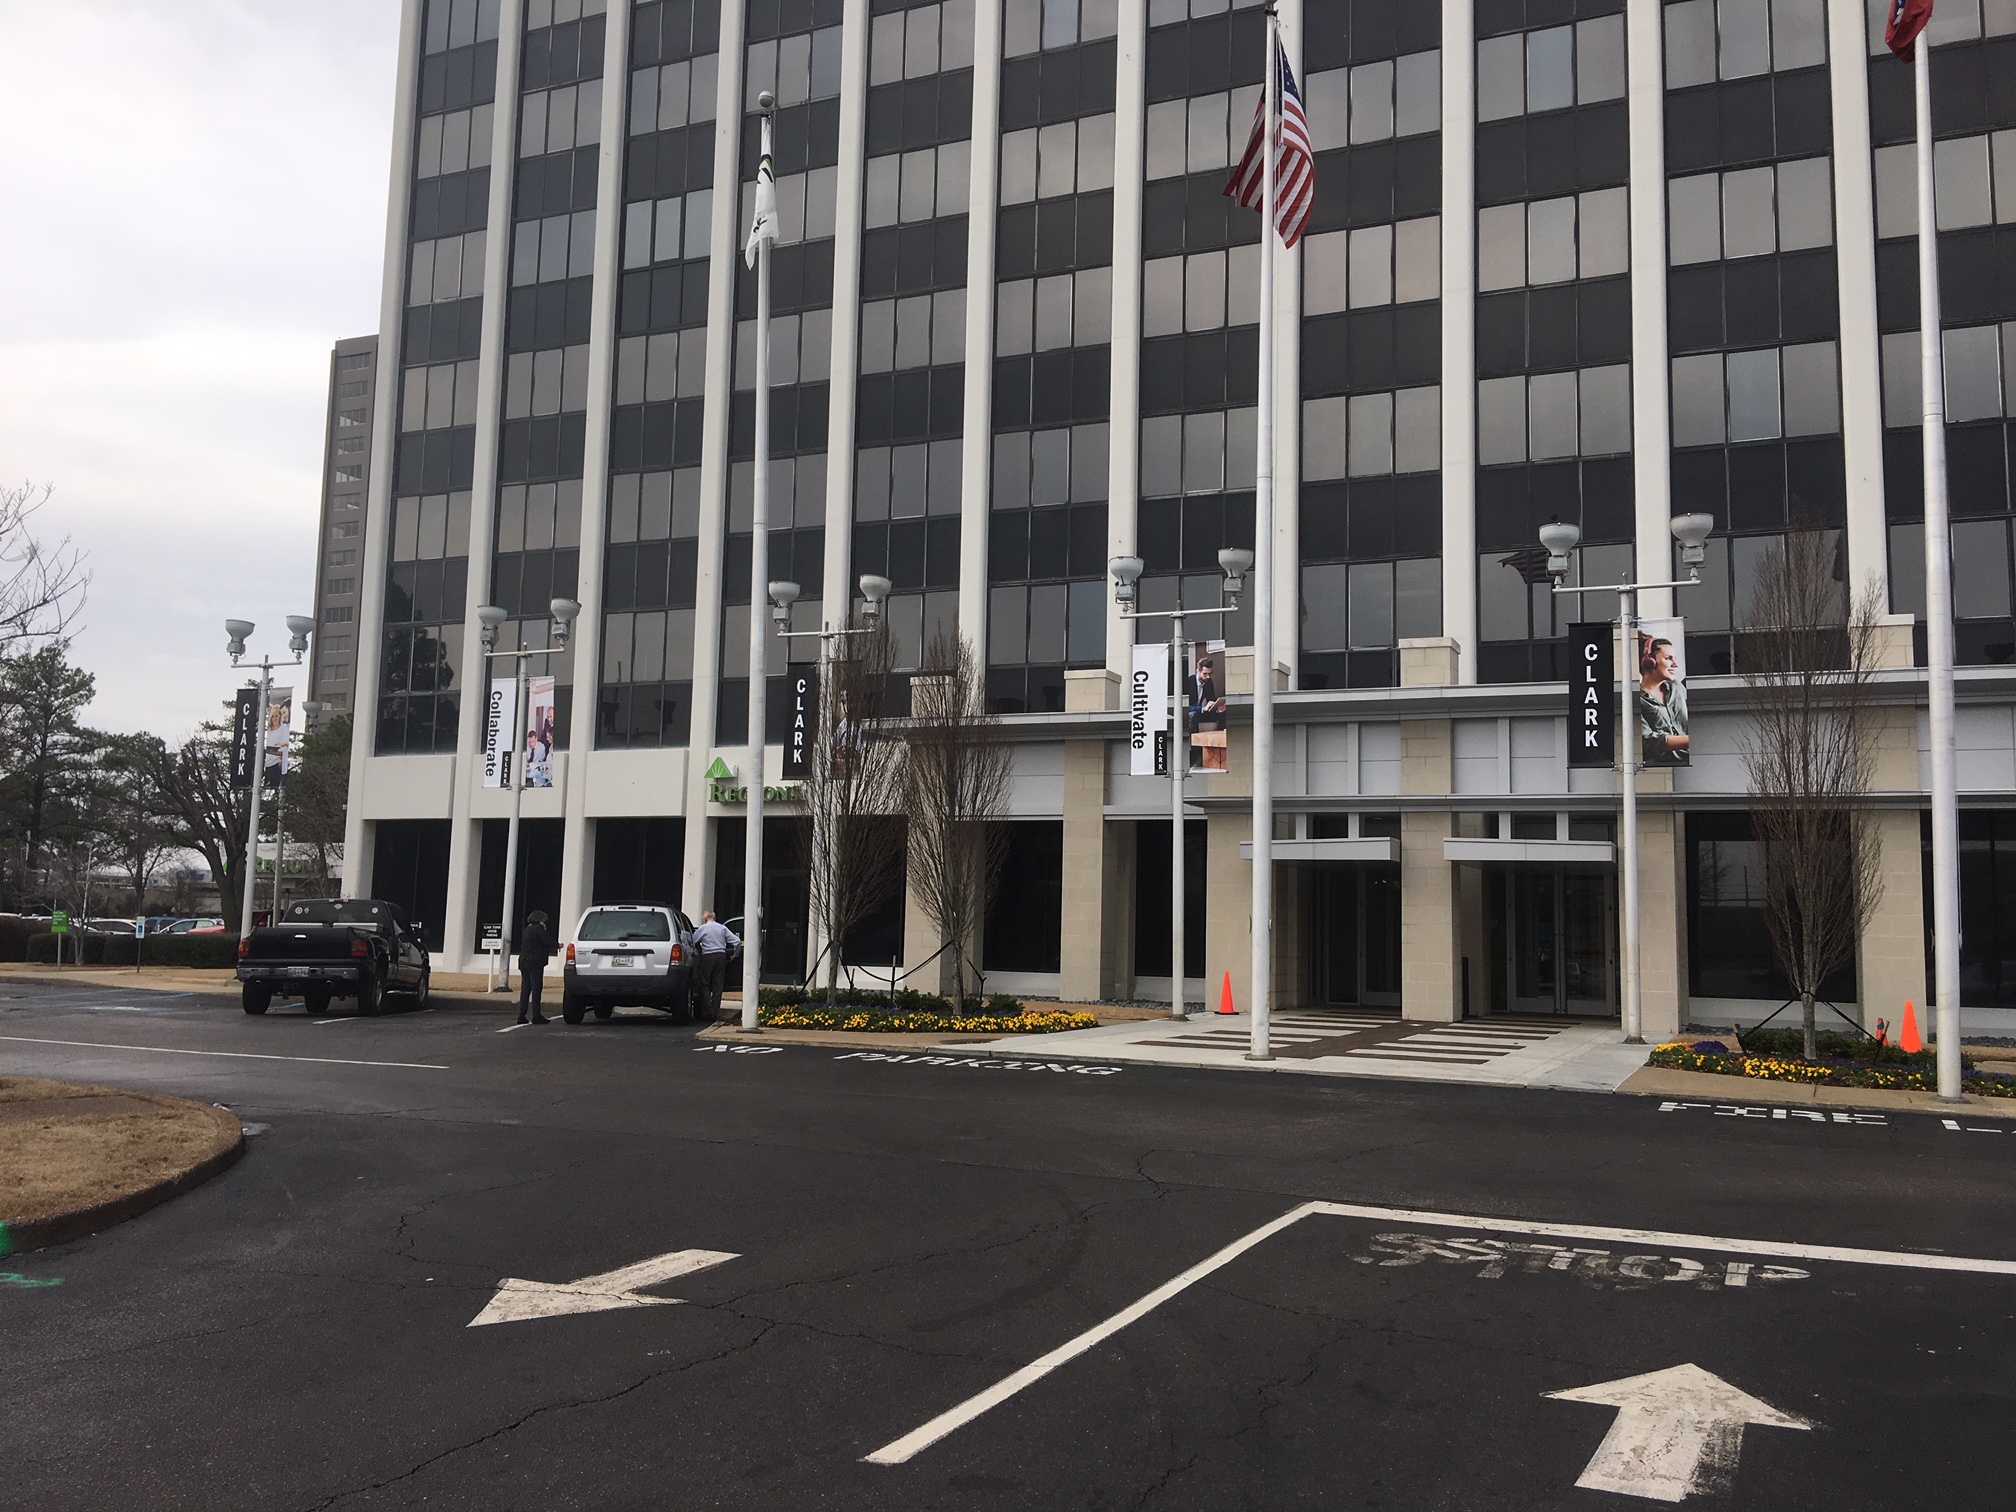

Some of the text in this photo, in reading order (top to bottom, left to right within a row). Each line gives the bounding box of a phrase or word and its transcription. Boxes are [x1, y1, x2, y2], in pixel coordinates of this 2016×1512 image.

[485, 691, 503, 777] Collaborate
[793, 679, 806, 764] CLARK
[1132, 671, 1149, 750] Cultivate
[1584, 643, 1599, 748] CLARK
[237, 703, 250, 776] CLARK
[692, 1045, 1123, 1075] NO PARKING
[1658, 1101, 1888, 1125] FIRE
